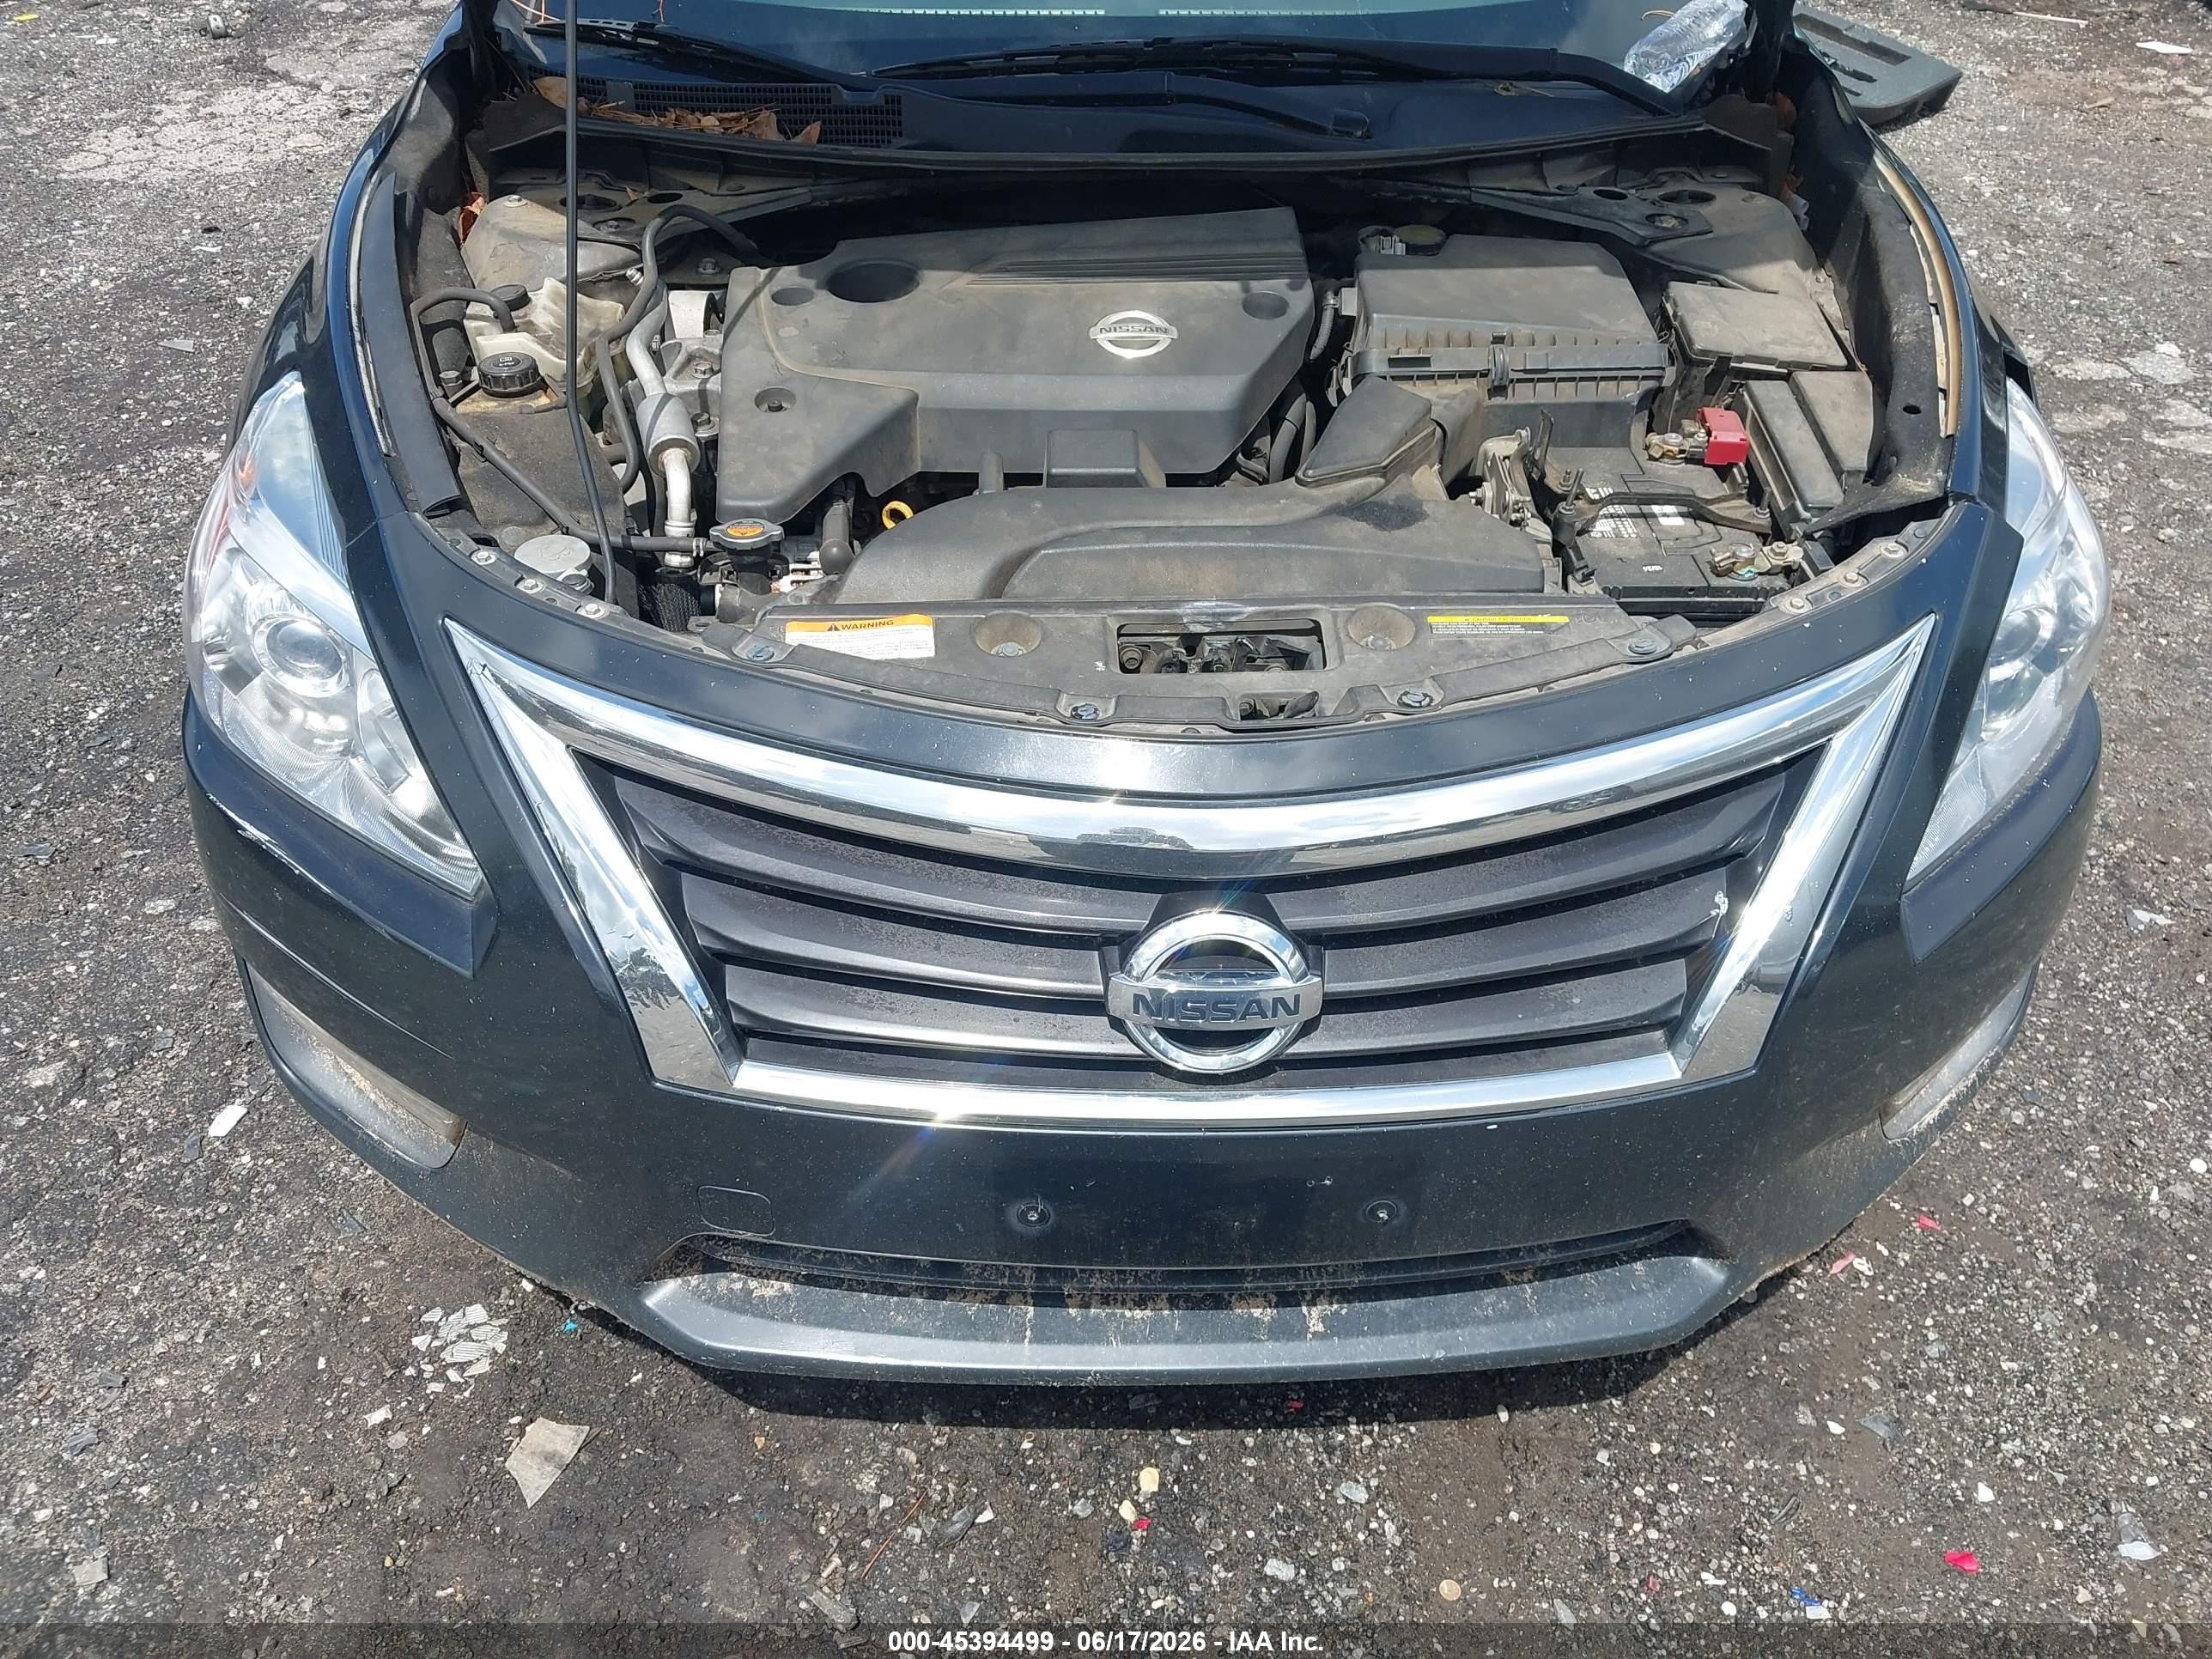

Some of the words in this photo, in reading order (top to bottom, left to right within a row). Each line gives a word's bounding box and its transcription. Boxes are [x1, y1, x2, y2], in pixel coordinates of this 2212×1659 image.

[1099, 325, 1168, 334] NISSAN
[841, 620, 894, 631] WARNING
[1132, 993, 1301, 1024] NISSAN
